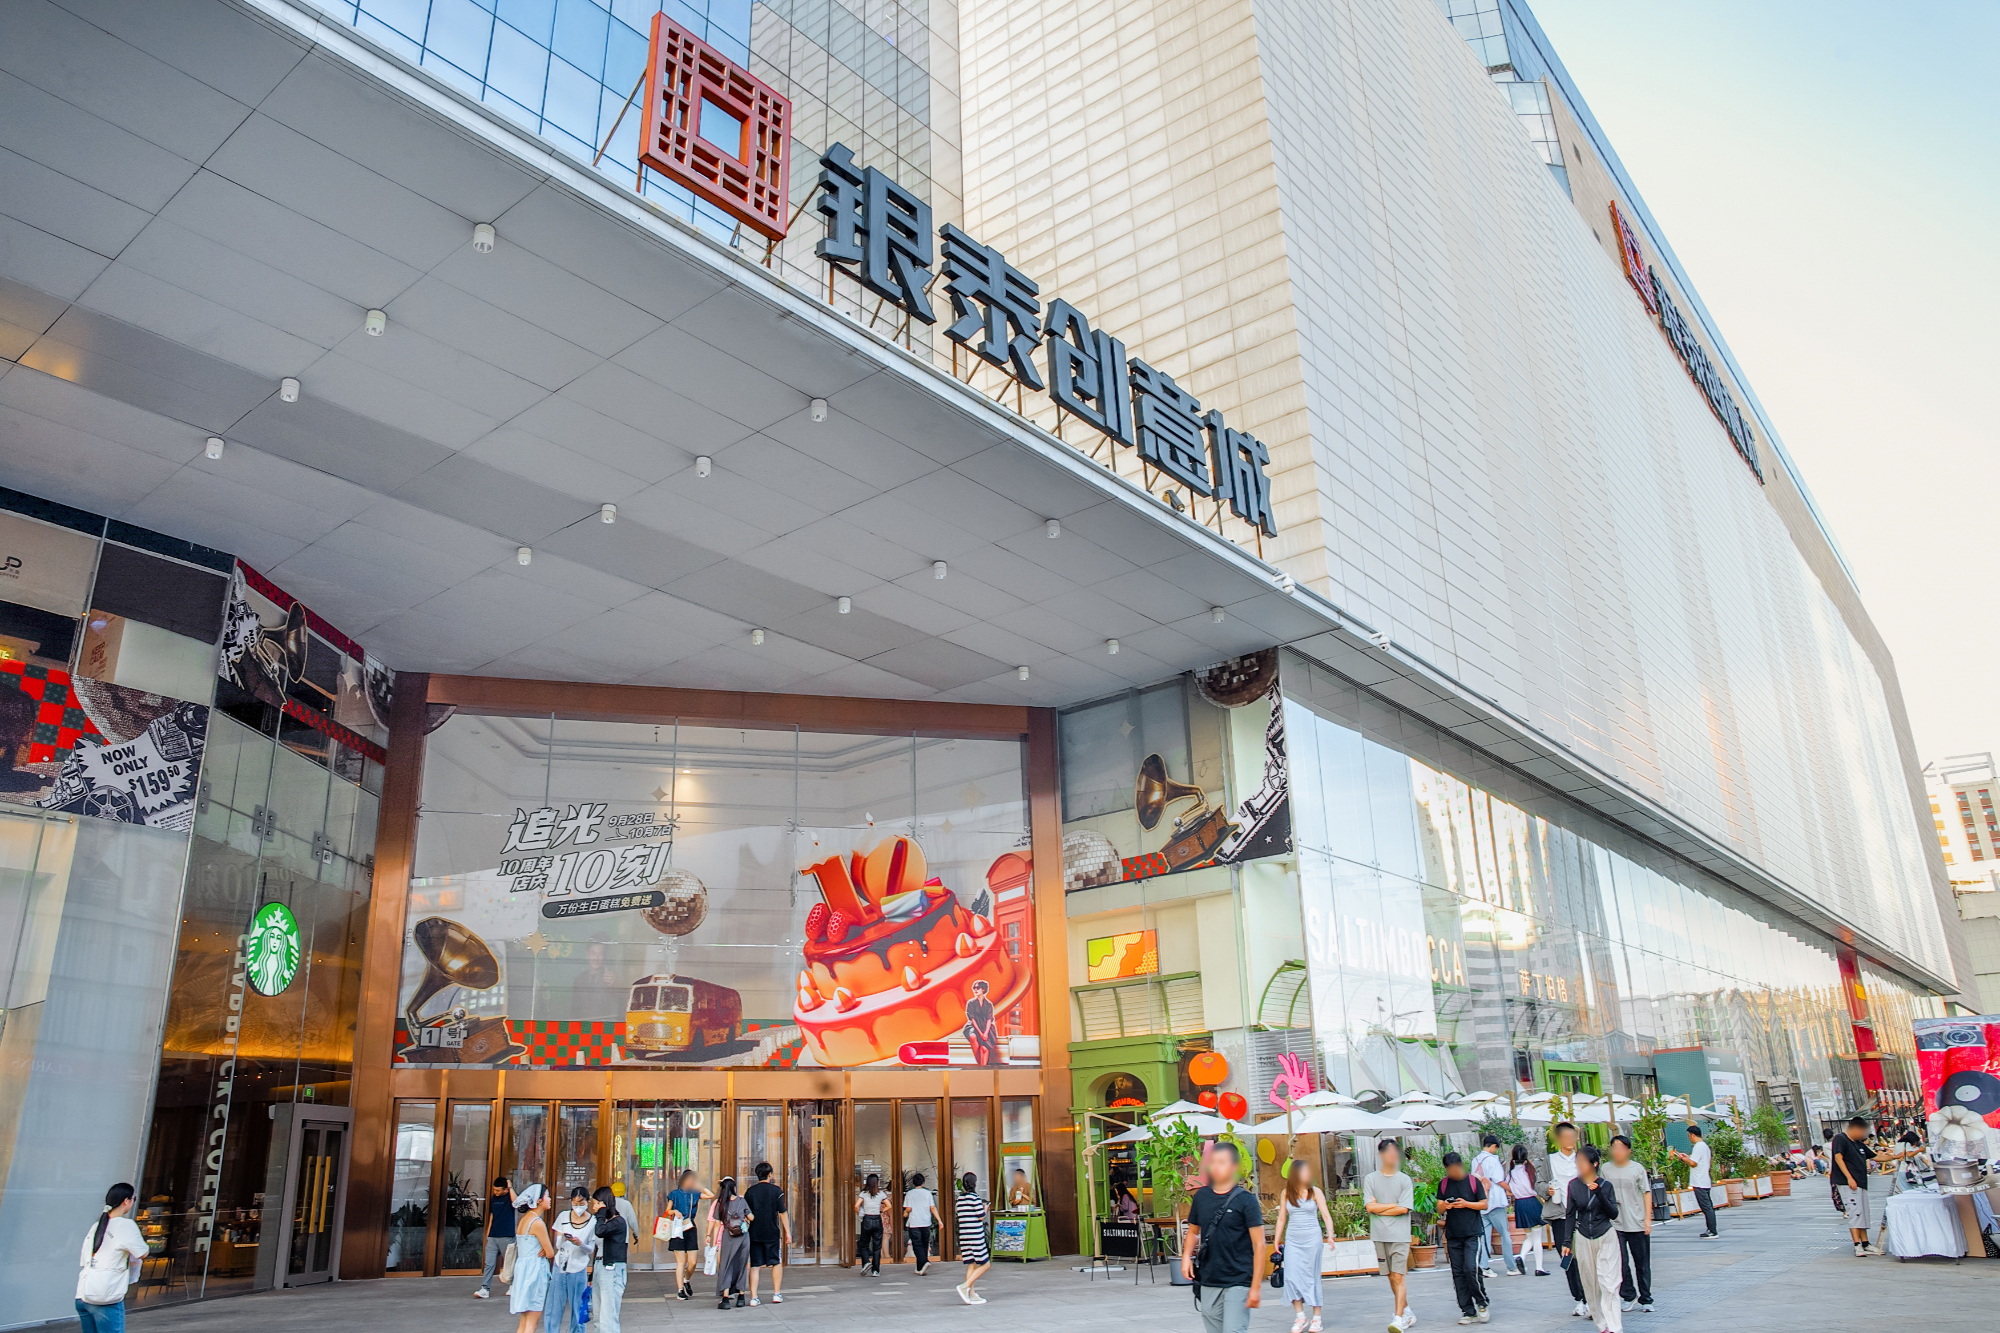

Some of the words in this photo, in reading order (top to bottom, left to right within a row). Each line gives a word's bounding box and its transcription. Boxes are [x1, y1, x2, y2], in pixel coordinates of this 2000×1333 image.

[816, 142, 1277, 539] 银泰创意城
[101, 745, 136, 765] NOW
[113, 756, 149, 776] ONLY
[500, 803, 608, 854] 追光
[608, 812, 655, 828] 9月28日
[629, 823, 673, 839] 10月7日
[497, 856, 554, 876] 10周年
[547, 841, 673, 897] 10刻
[556, 894, 652, 915] 万份生日蛋糕免费送
[1307, 907, 1466, 987] SALTIMBOCCA
[1002, 1146, 1032, 1154] WELCOME
[1103, 1228, 1138, 1238] SALTIMBOCCA
